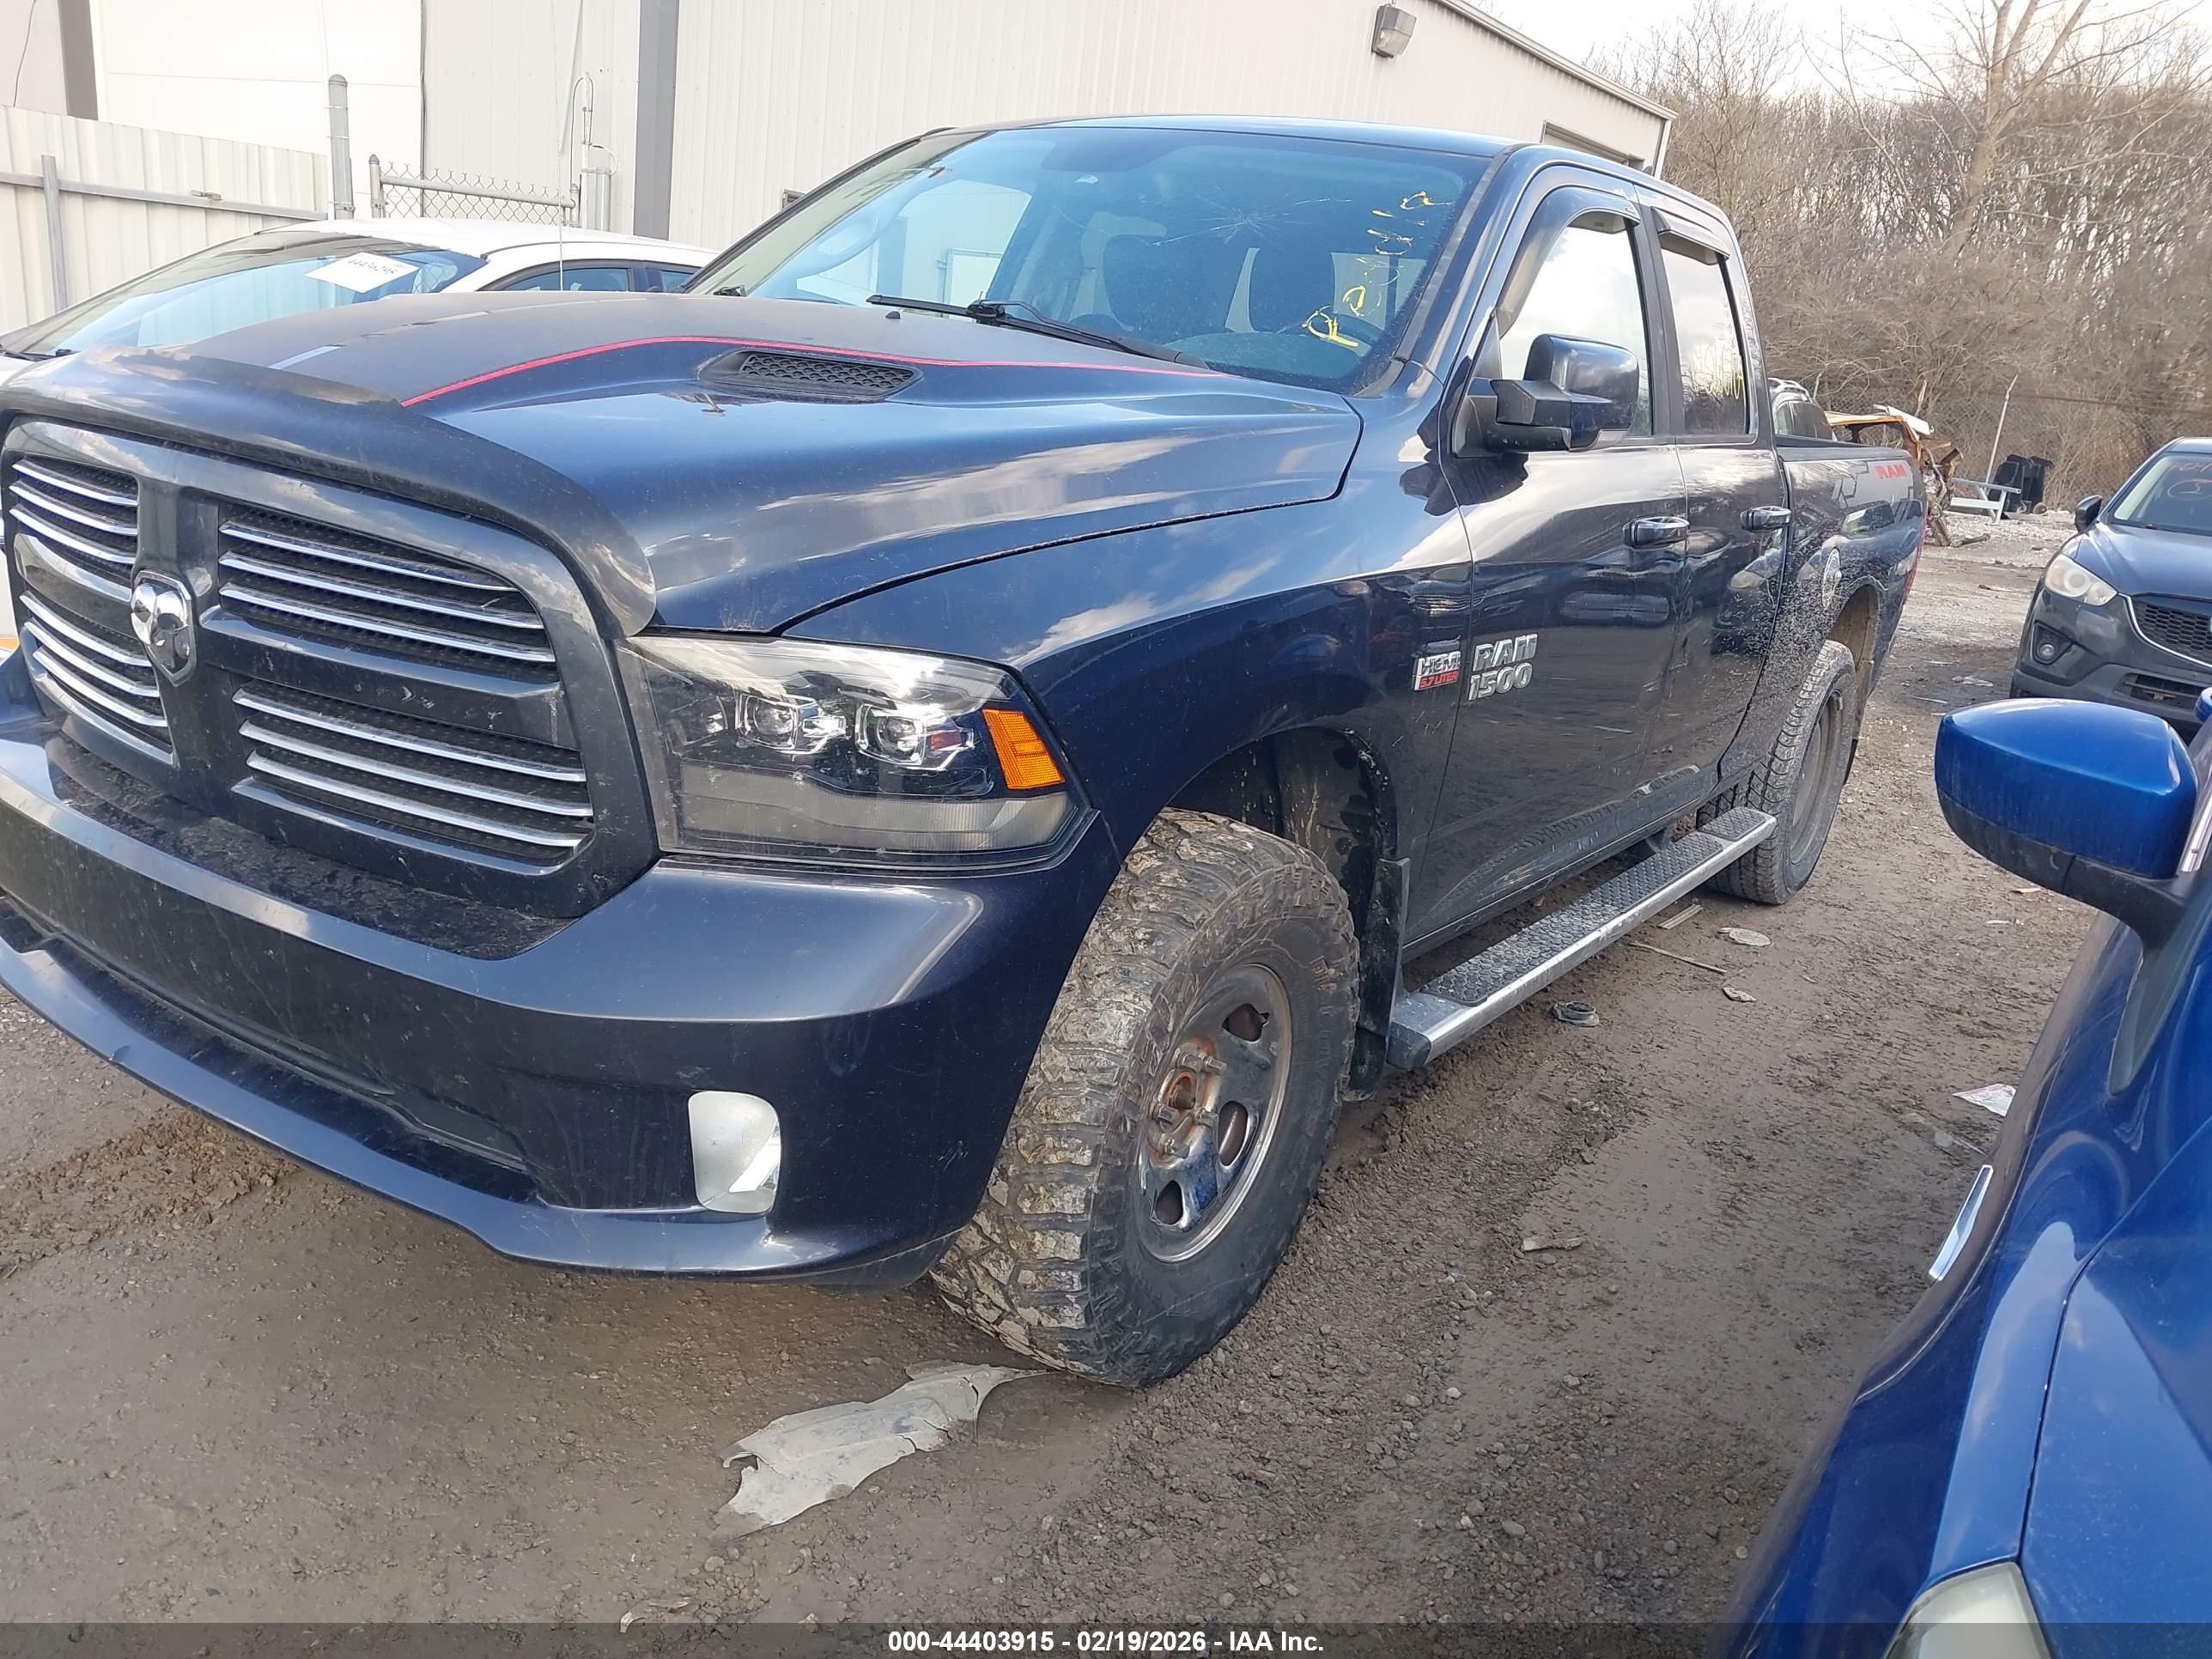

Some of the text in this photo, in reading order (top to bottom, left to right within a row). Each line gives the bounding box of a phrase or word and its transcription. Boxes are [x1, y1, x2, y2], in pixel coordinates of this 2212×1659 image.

[1875, 465, 1907, 479] RAM
[1417, 651, 1461, 676] HEMI
[1473, 634, 1538, 672] RAM
[1434, 670, 1458, 684] LITER
[1468, 662, 1533, 701] 1500
